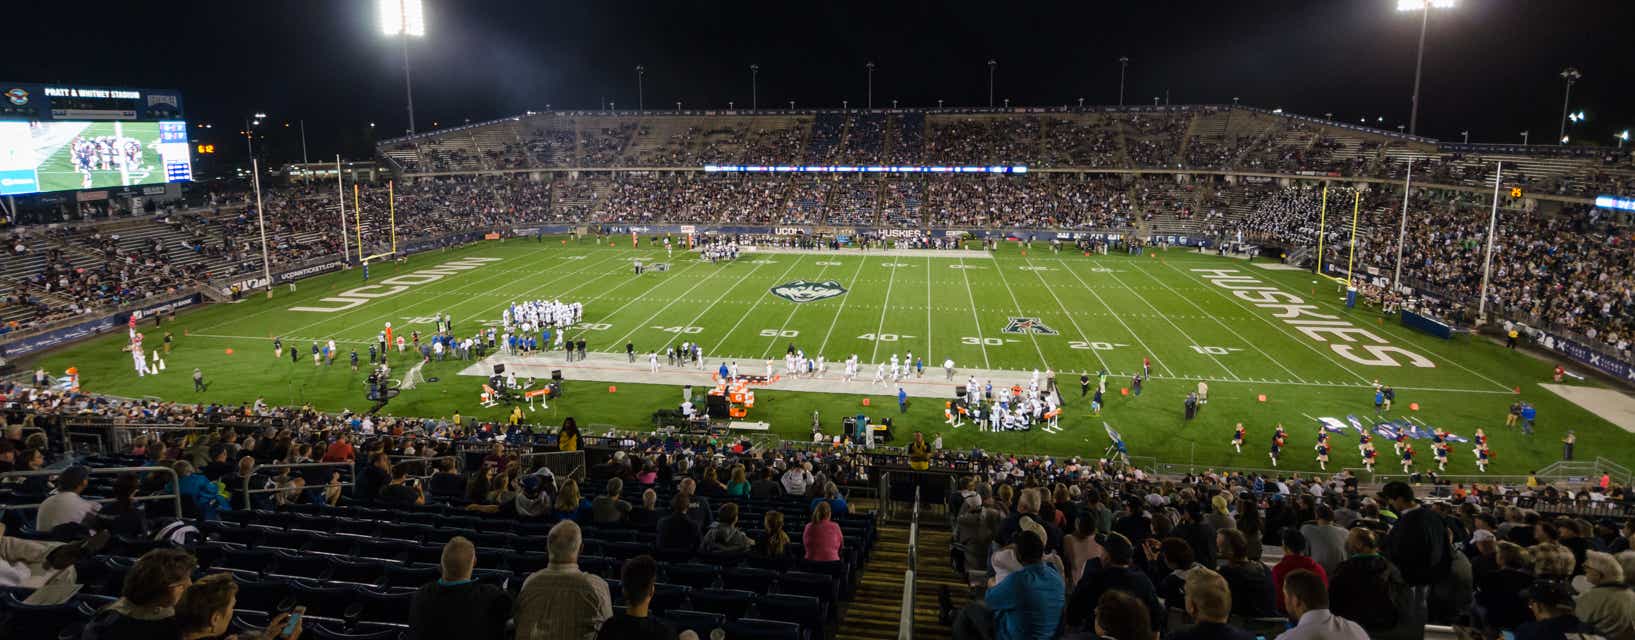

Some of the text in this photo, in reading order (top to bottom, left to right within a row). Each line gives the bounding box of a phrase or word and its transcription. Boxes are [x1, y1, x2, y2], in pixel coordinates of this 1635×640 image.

[44, 88, 140, 99] PRATT & WHITNEY STADIUM
[775, 227, 805, 235] UCON
[879, 229, 920, 237] HUSKIES
[288, 257, 504, 313] UCONN
[1190, 268, 1436, 368] HUSKIES
[663, 326, 704, 334] 40
[760, 329, 800, 338] 50
[856, 333, 899, 341] 40
[960, 336, 1004, 346] 30
[1067, 341, 1115, 351] 20
[1190, 346, 1229, 355] 10
